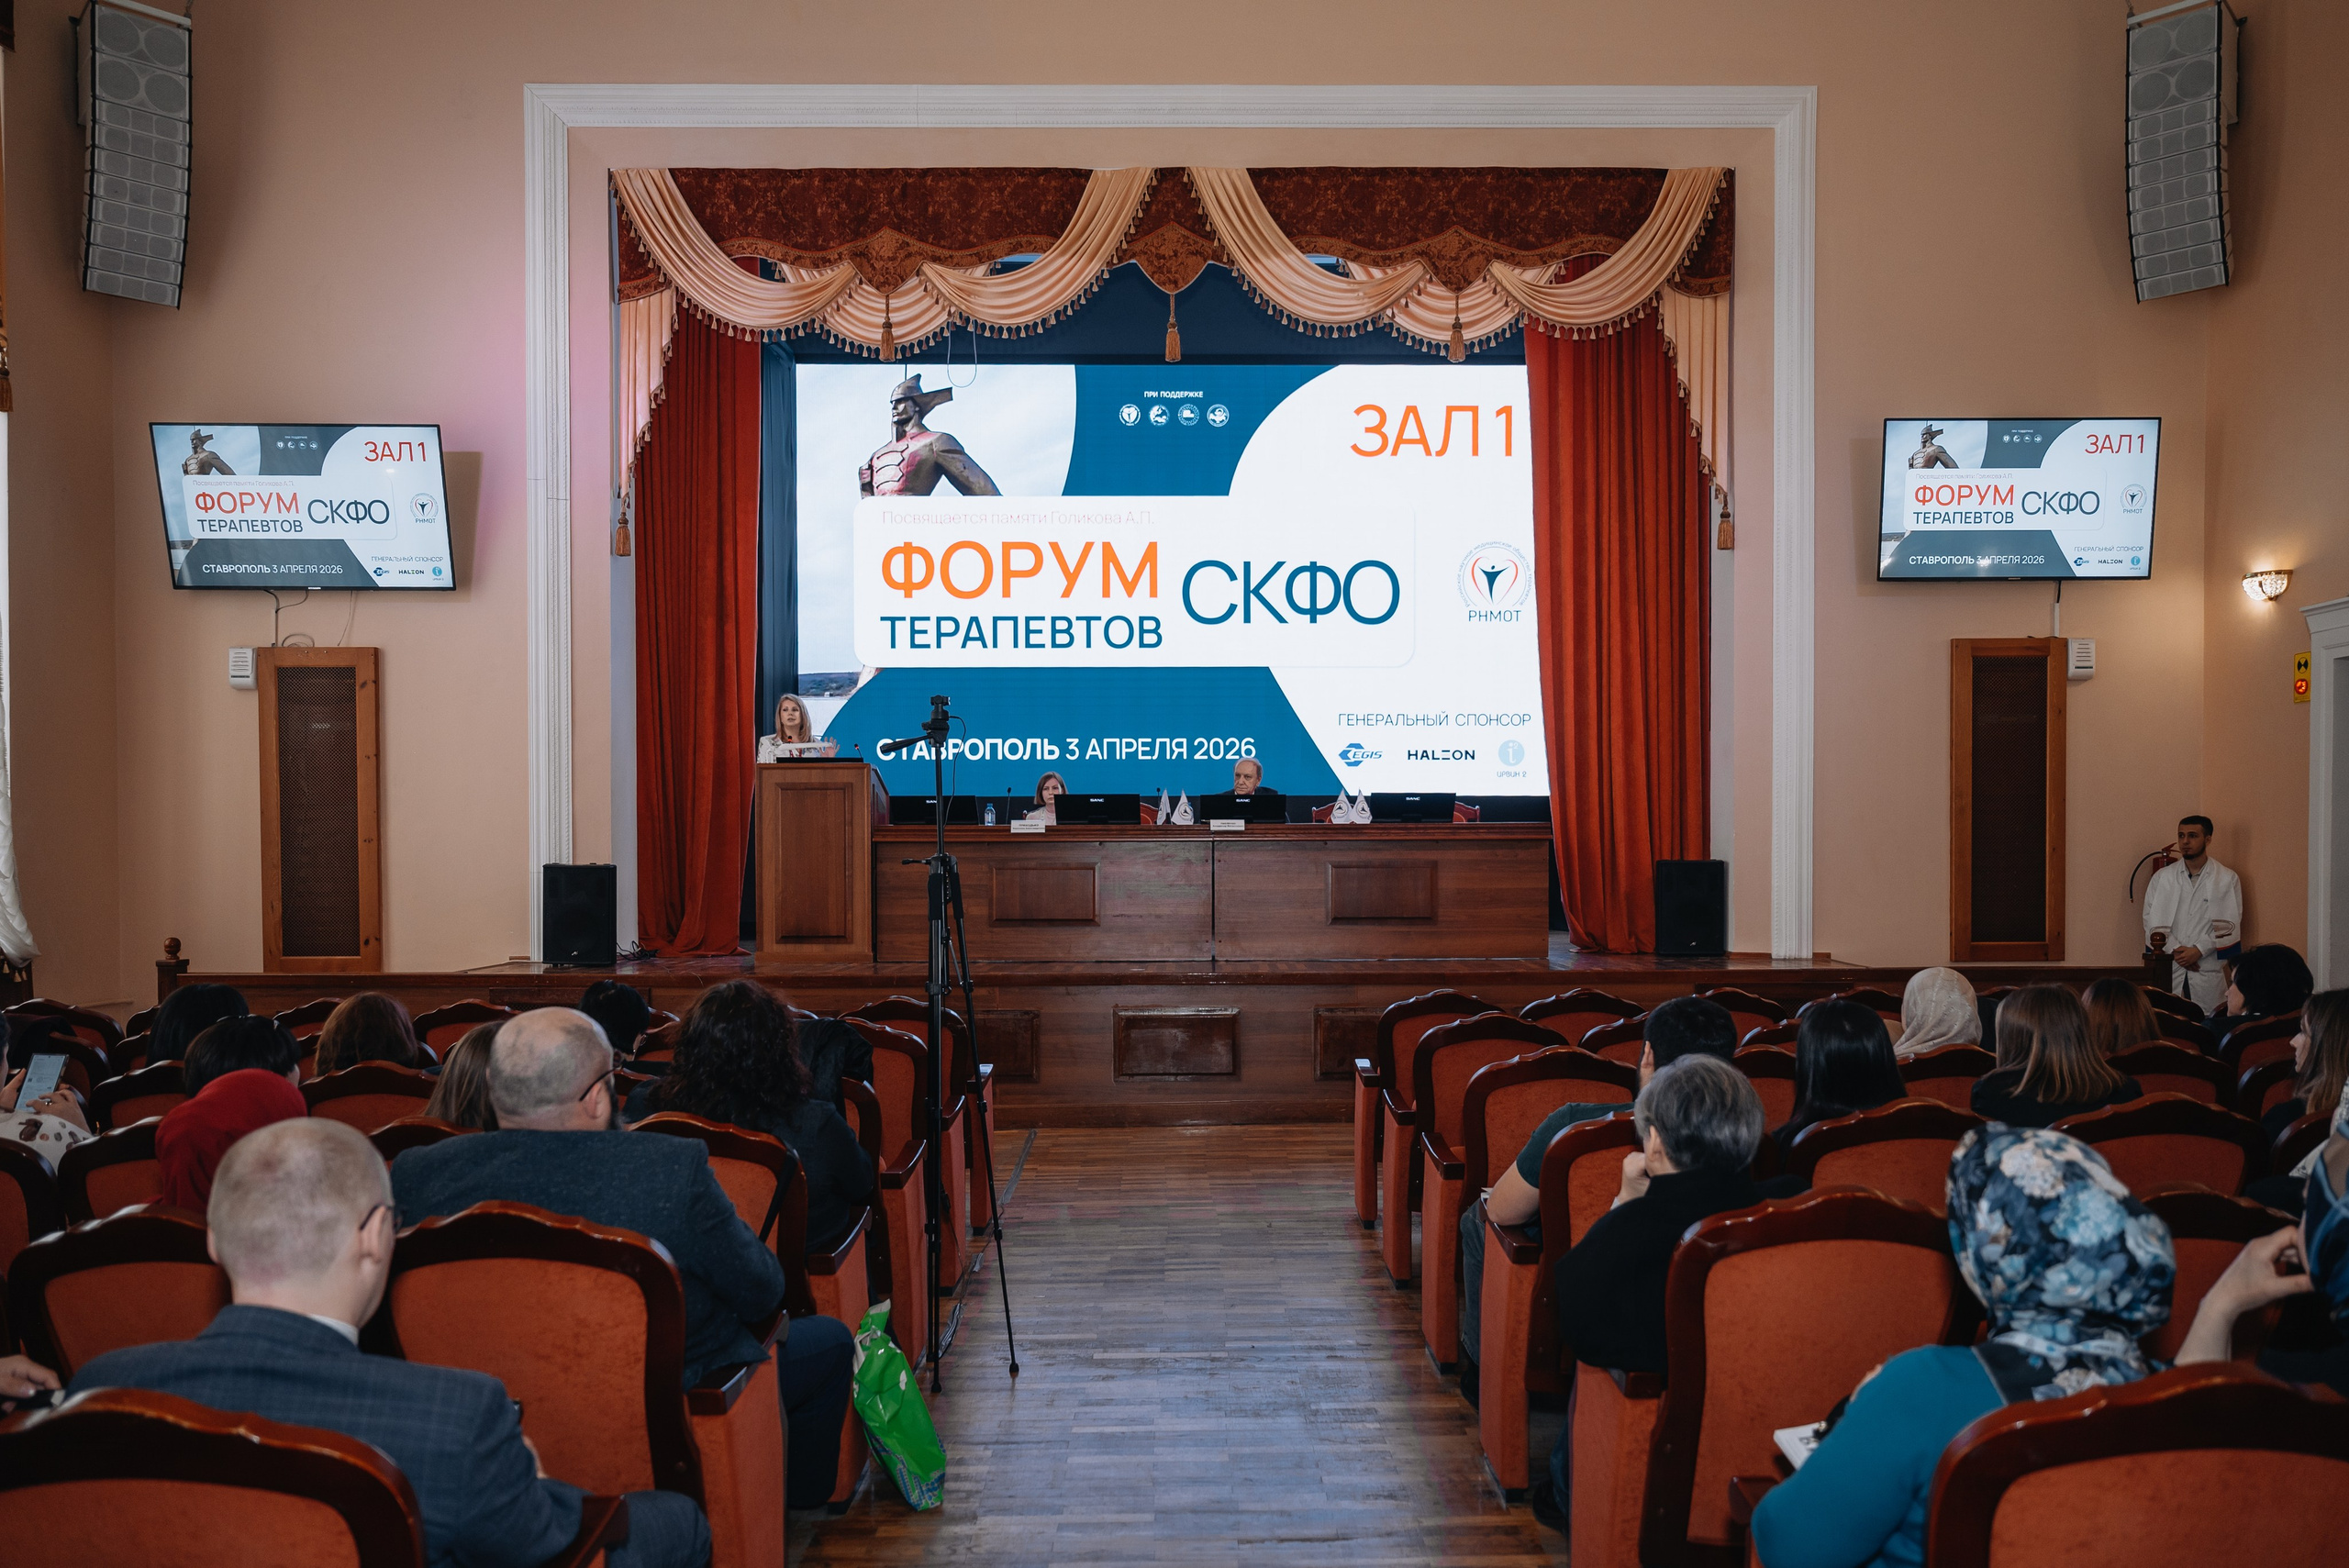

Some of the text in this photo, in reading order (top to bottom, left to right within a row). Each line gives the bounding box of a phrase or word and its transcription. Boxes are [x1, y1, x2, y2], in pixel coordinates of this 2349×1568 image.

[1160, 391, 1204, 399] ПОДДЕРЖКЕ
[1350, 404, 1513, 457] ЗАЛ 1
[363, 440, 427, 462] ЗАЛ 1
[2084, 434, 2144, 454] ЗАЛ 1
[195, 491, 300, 515] ФОРУМ
[1914, 484, 2014, 506] ФОРУМ
[2021, 490, 2100, 516] СКФО
[307, 499, 390, 524] СКФО
[882, 511, 1155, 527] Посвящается памяти Голикова А.П.
[1913, 511, 2014, 525] ТЕРАПЕВТОВ
[197, 518, 304, 533] ТЕРАПЕВТОВ
[202, 563, 343, 574] СТАВРОПОЛЬ 3 АПРЕЛЯ 2026
[882, 540, 1158, 599] ФОРУМ
[1909, 555, 1975, 565] СТАВРОПОЛЬ
[2021, 555, 2045, 564] 2026
[1182, 560, 1400, 626] СКФО
[1468, 609, 1521, 622] РНМОТ
[880, 615, 1163, 650] ТЕРАПЕВТОВ
[1338, 710, 1531, 727] ГЕНЕРАЛЬНЫЙ СПОНСОР
[1065, 738, 1080, 761] 3
[1085, 738, 1187, 761] АПРЕЛЯ
[1193, 737, 1256, 761] 2026
[1352, 751, 1384, 760] EGIS
